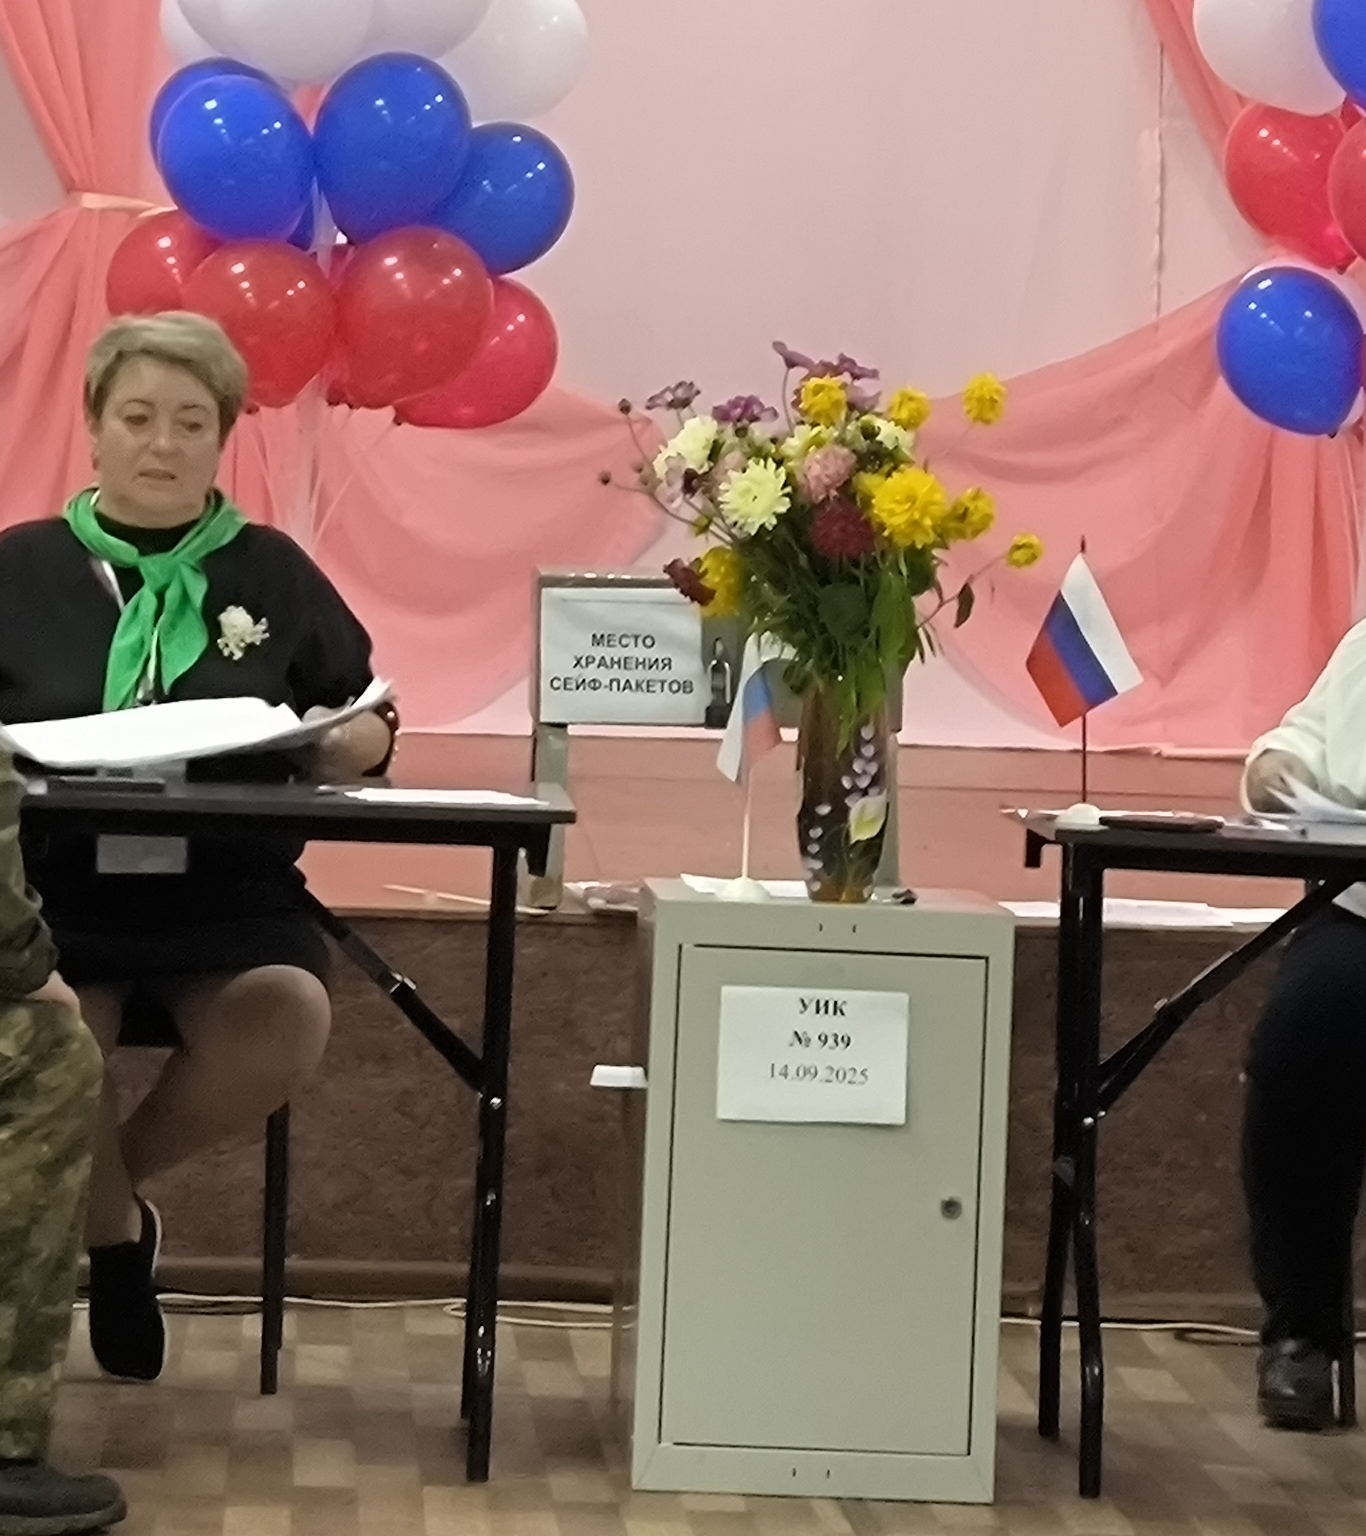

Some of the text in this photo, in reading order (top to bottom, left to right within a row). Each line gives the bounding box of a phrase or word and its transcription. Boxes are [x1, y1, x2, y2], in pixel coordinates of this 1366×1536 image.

[591, 633, 656, 650] МЕСТО
[572, 654, 673, 671] ХРАНЕНИЯ
[549, 674, 695, 695] СЕЙФ-ПАКЕТОВ
[798, 997, 848, 1016] УИК
[788, 1030, 852, 1050] № 939
[768, 1063, 869, 1085] 14.09.2025
